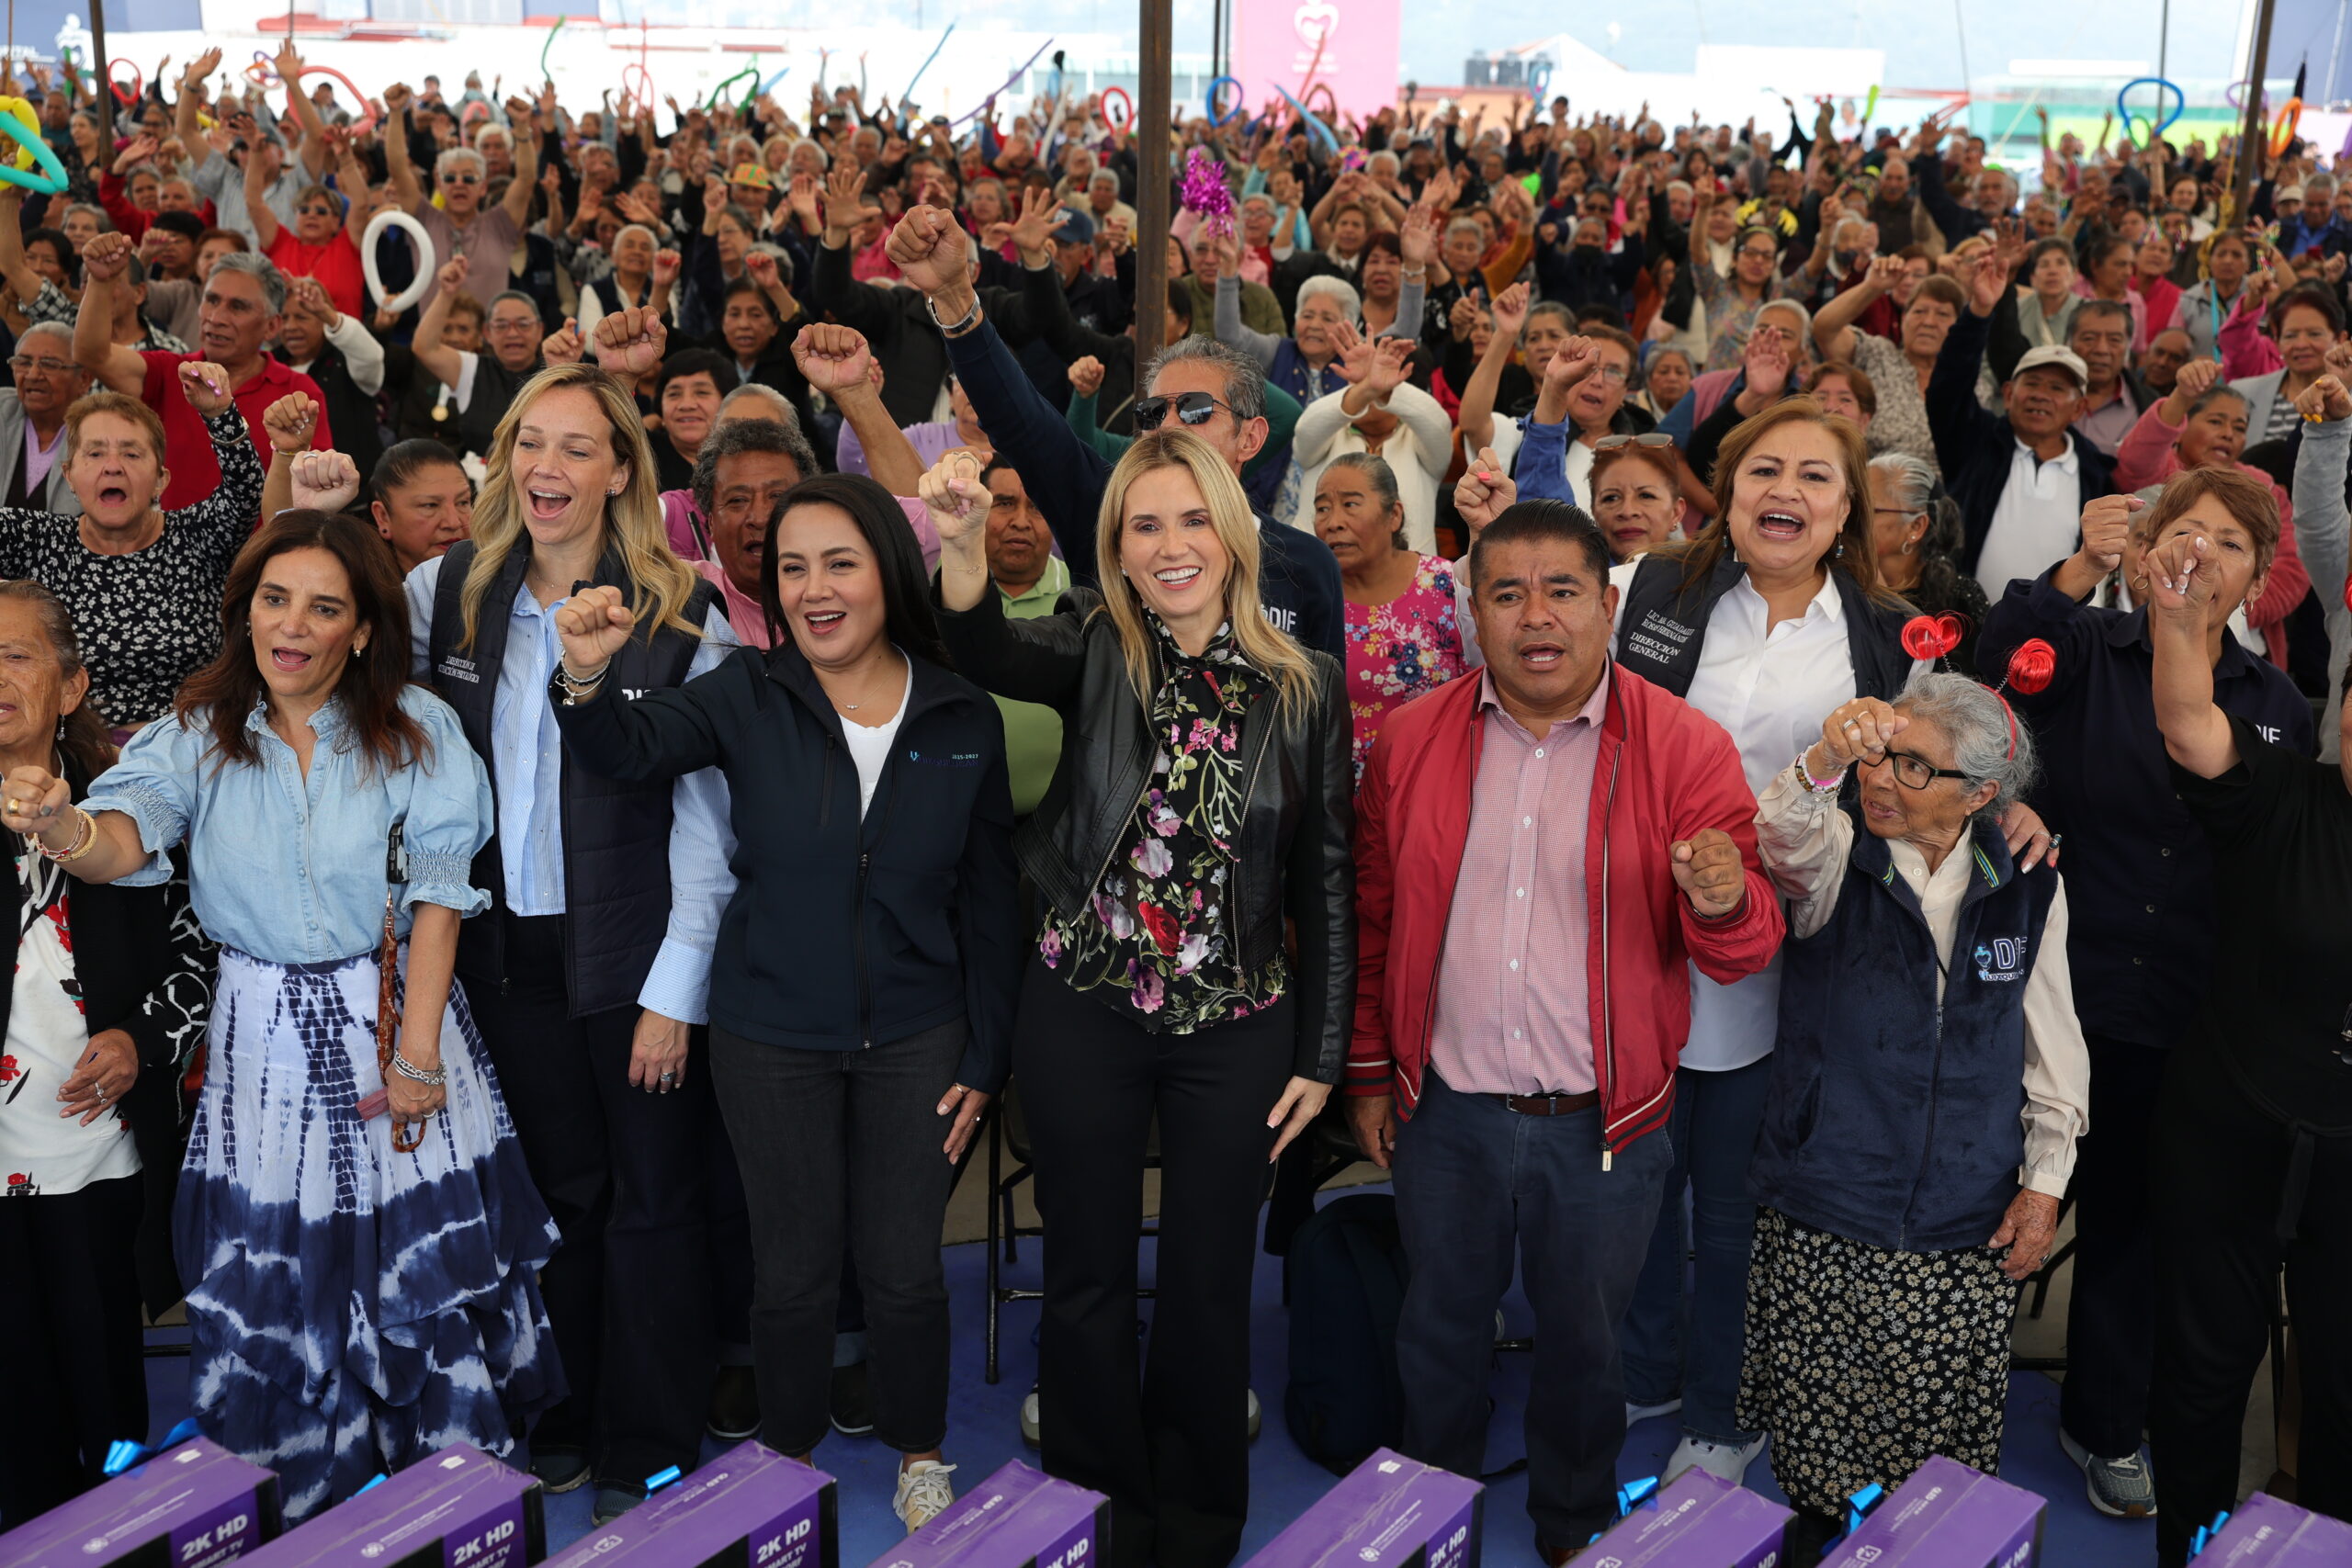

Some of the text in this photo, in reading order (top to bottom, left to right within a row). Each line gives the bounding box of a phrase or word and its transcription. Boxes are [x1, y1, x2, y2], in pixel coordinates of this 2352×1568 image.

[1269, 606, 1296, 633] DIF
[1628, 642, 1670, 664] GENERAL
[1630, 631, 1681, 657] DIRECCIÓN
[2256, 724, 2281, 744] IF
[180, 1531, 213, 1562] 2K
[216, 1514, 248, 1542] HD
[453, 1537, 481, 1566] 2K
[485, 1519, 514, 1548] HD
[496, 1544, 511, 1558] TV
[756, 1535, 782, 1563] 2K
[785, 1518, 811, 1545] HD
[794, 1542, 808, 1556] TV
[1430, 1525, 1466, 1568] 2K HD
[1067, 1538, 1089, 1566] HD
